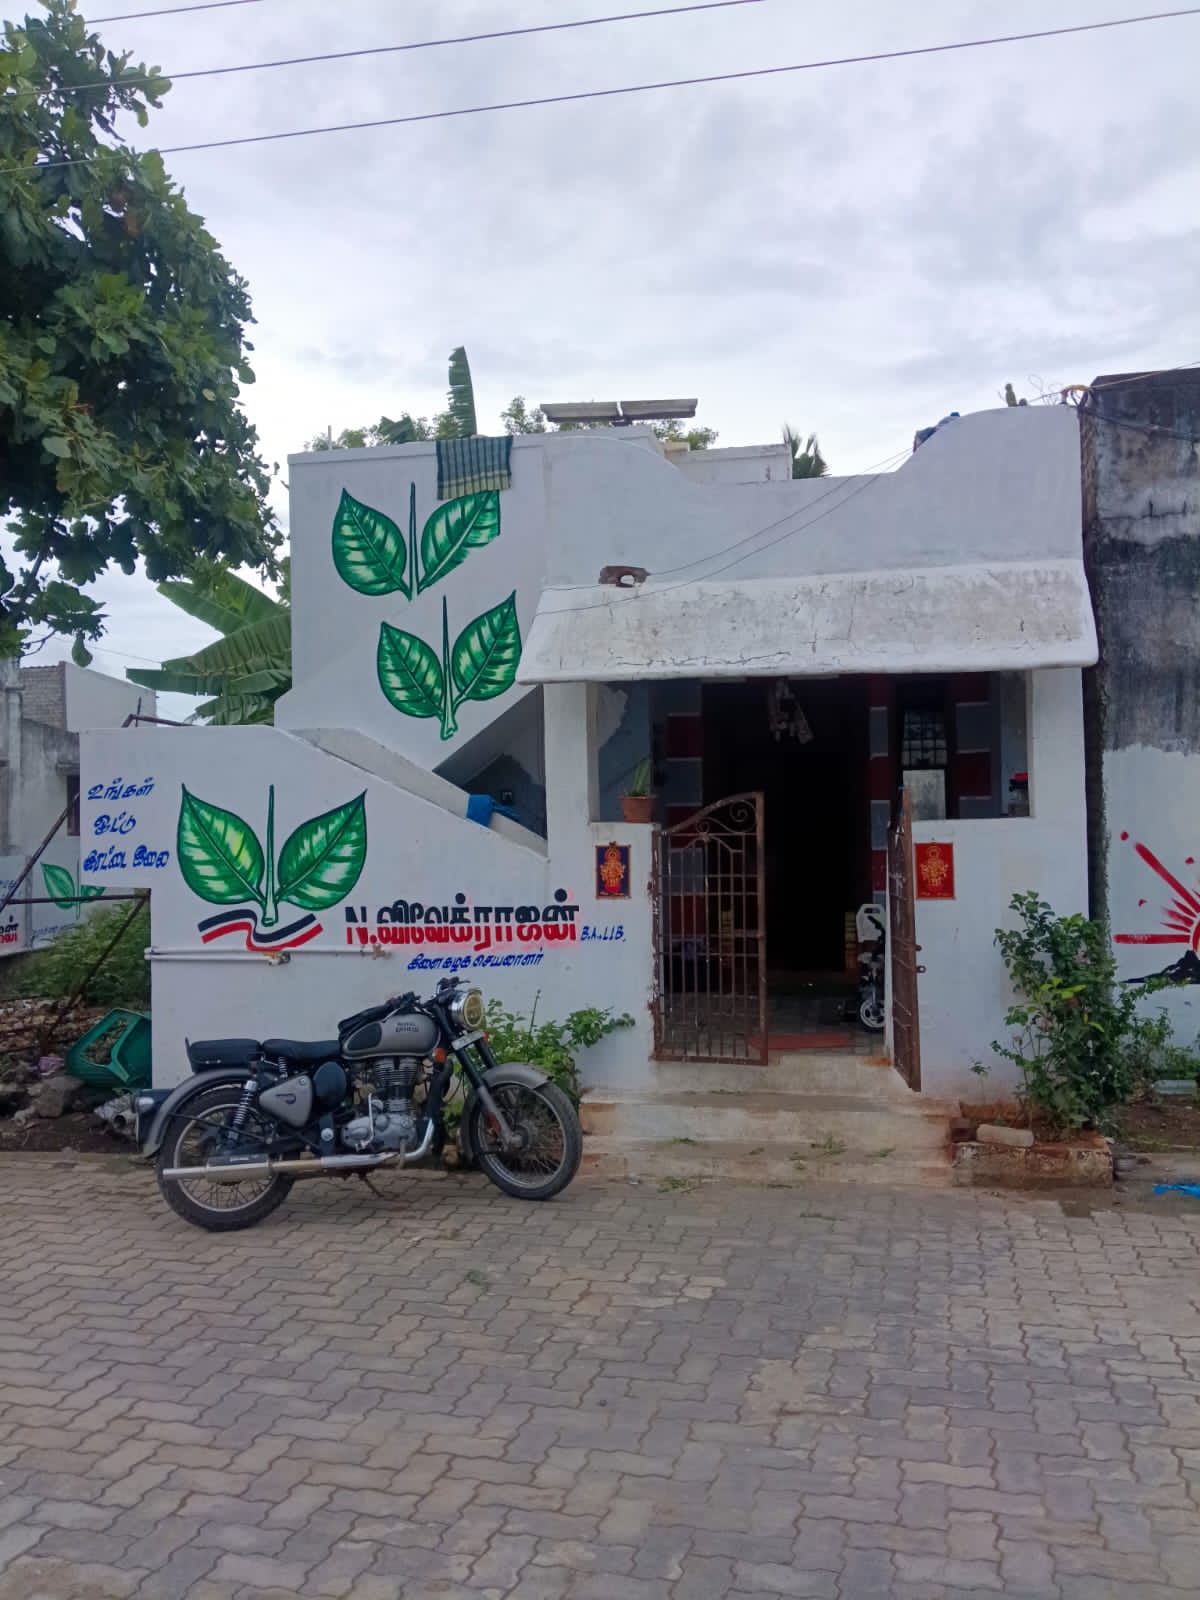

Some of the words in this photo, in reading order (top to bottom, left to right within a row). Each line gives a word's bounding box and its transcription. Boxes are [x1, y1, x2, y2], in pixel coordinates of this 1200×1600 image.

[87, 777, 155, 801] உங்கள்
[83, 845, 127, 872] இரட்டை
[132, 844, 170, 869] இலை
